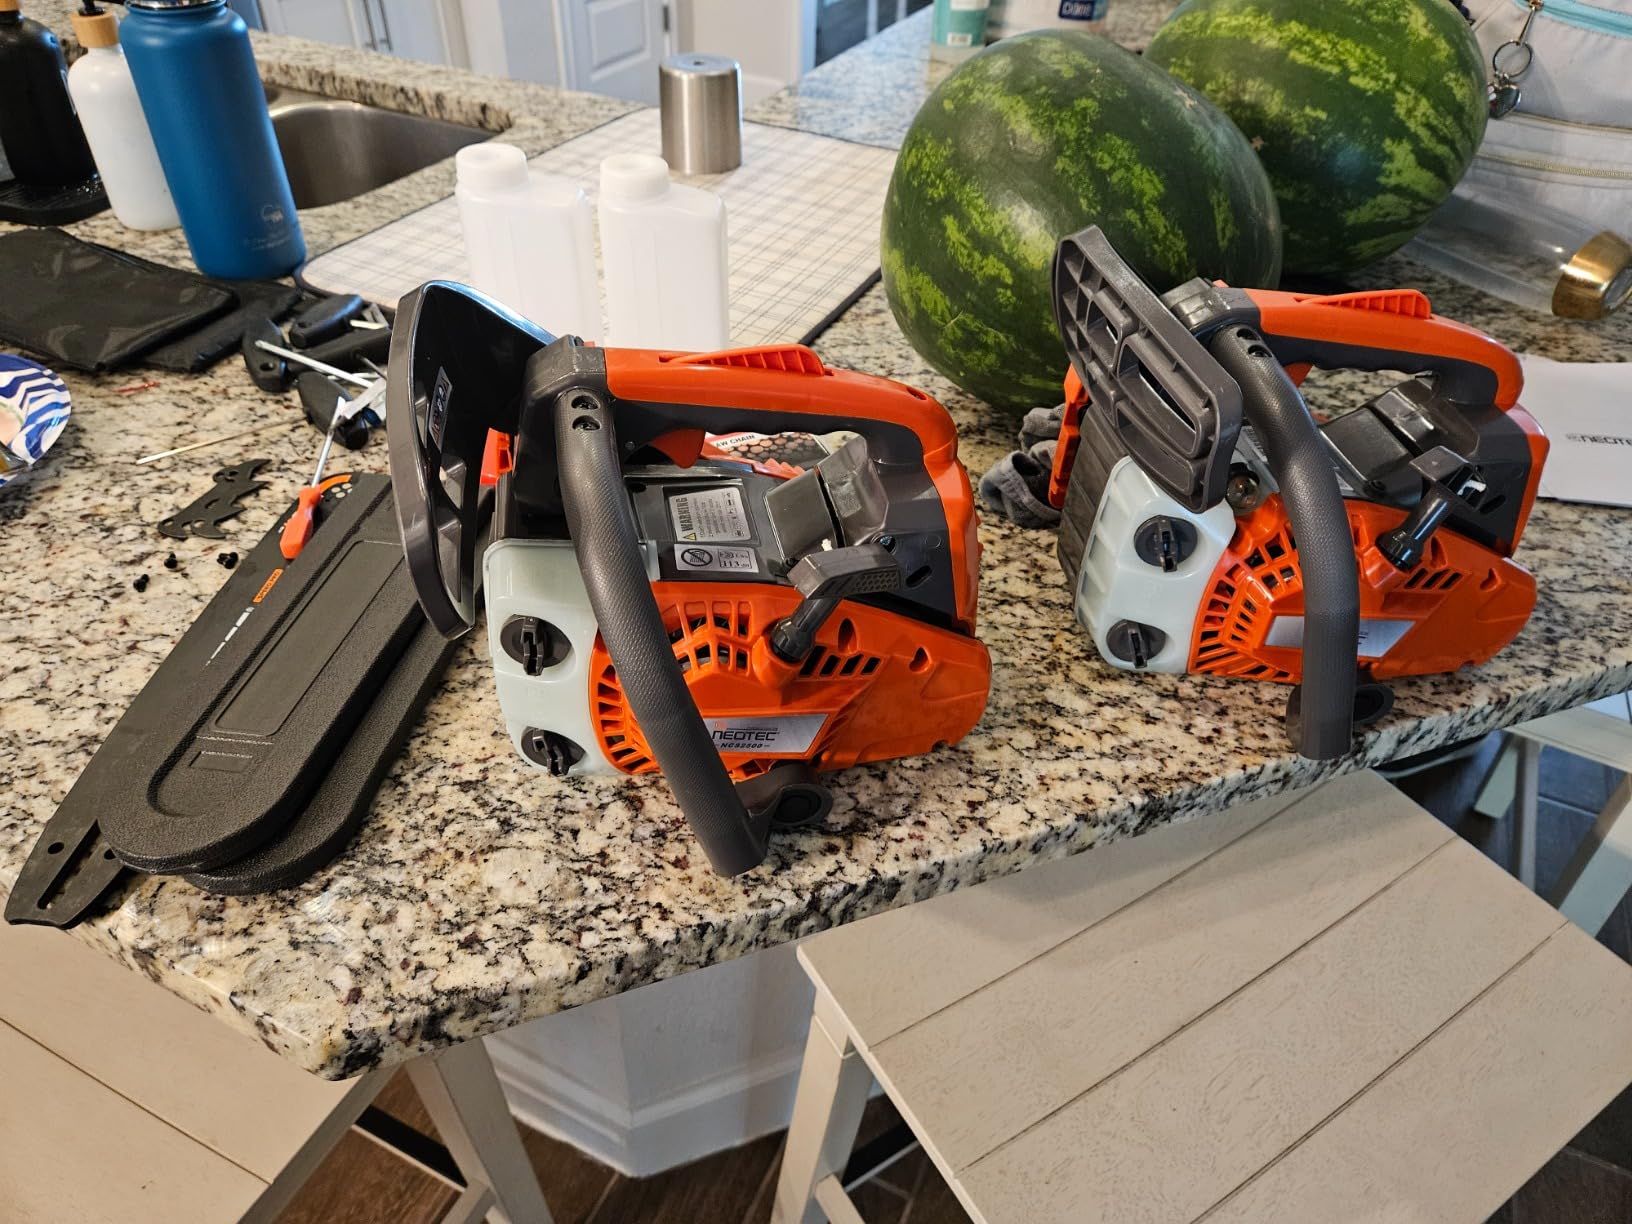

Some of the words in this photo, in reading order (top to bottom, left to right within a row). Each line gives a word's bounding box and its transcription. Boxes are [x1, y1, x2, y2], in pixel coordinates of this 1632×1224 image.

[730, 434, 755, 444] CHAIN
[675, 497, 694, 532] WARNING
[711, 730, 777, 741] NEOTEC
